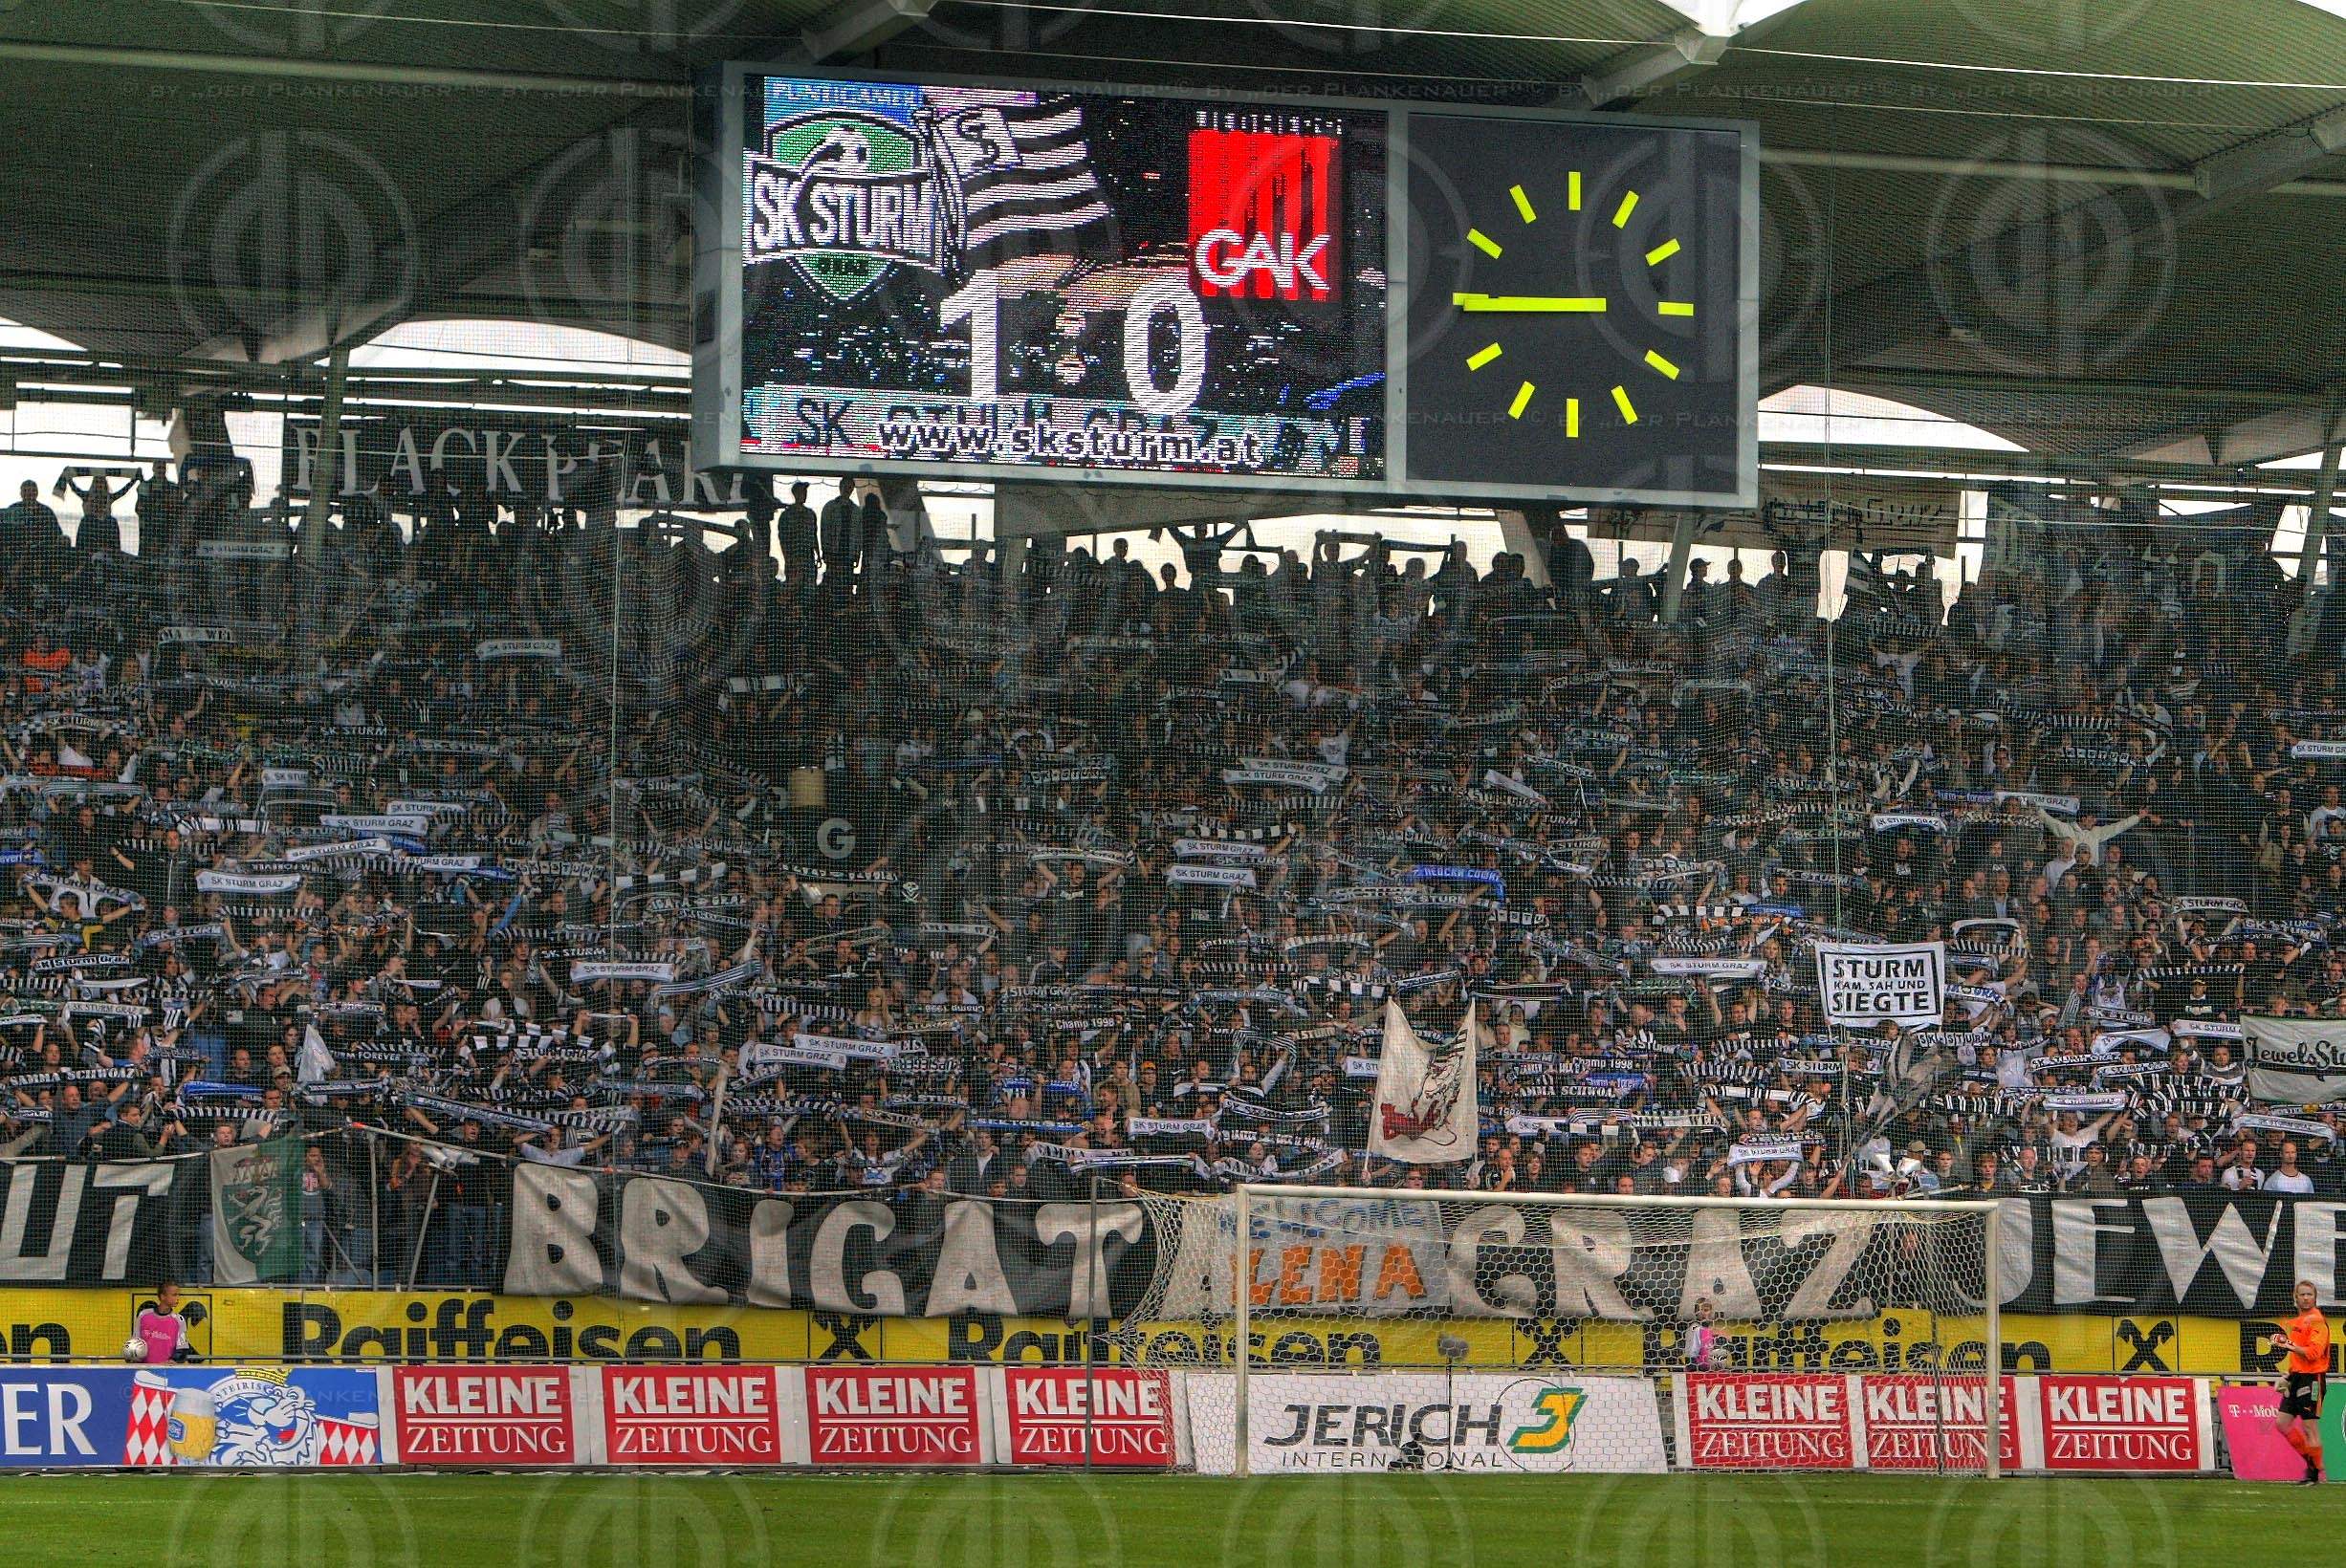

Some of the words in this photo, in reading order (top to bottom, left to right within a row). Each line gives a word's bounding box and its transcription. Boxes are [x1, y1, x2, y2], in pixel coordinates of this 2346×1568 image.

[752, 170, 805, 249] SK
[810, 182, 935, 256] STURM
[1195, 228, 1332, 292] GAK
[940, 270, 998, 403] 1
[1125, 283, 1206, 414] 0
[878, 418, 1262, 466] www.sksturm.at
[543, 434, 752, 505] PAR
[353, 818, 385, 827] STURM
[387, 818, 414, 827] GRAZ
[347, 838, 378, 850] GRAZ
[816, 817, 856, 859] G
[225, 878, 256, 888] STURM
[258, 879, 284, 888] GRAZ
[1190, 870, 1220, 880] STURM
[1222, 872, 1247, 882] GRAZ
[175, 925, 222, 937] STURM
[562, 947, 605, 957] STURM
[1832, 959, 1925, 979] STURM
[1869, 981, 1893, 991] SAH
[1897, 979, 1926, 990] UND
[1831, 991, 1930, 1013] SIEGTE
[1055, 1019, 1089, 1030] Champ
[1092, 1018, 1115, 1028] 1998
[773, 1049, 804, 1059] STURM
[806, 1052, 831, 1061] GRAZ
[823, 1040, 857, 1052] STURM
[858, 1044, 886, 1055] GRAZ
[10, 1070, 60, 1086] SAMMA
[1787, 1060, 1802, 1071] SK
[1805, 1060, 1843, 1072] STURM
[1445, 1200, 1877, 1320] GRAZ
[1230, 1244, 1428, 1306] LENA
[282, 1298, 741, 1364] Raiffeisen
[404, 1377, 562, 1416] KLEINE
[613, 1376, 769, 1415] KLEINE
[815, 1377, 969, 1415] KLEINE
[1014, 1378, 1165, 1416] KLEINE
[1697, 1383, 1841, 1422] KLEINE
[2050, 1386, 2188, 1423] KLEINE
[2, 1383, 98, 1455] ER
[1264, 1404, 1502, 1448] JERICH
[406, 1425, 567, 1455] ZEITUNG
[615, 1426, 773, 1455] ZEITUNG
[819, 1426, 973, 1455] ZEITUNG
[1019, 1426, 1169, 1456] ZEITUNG
[1699, 1432, 1844, 1459] ZEITUNG
[2052, 1434, 2193, 1461] ZEITUNG
[1282, 1450, 1504, 1470] INTERNONAL
